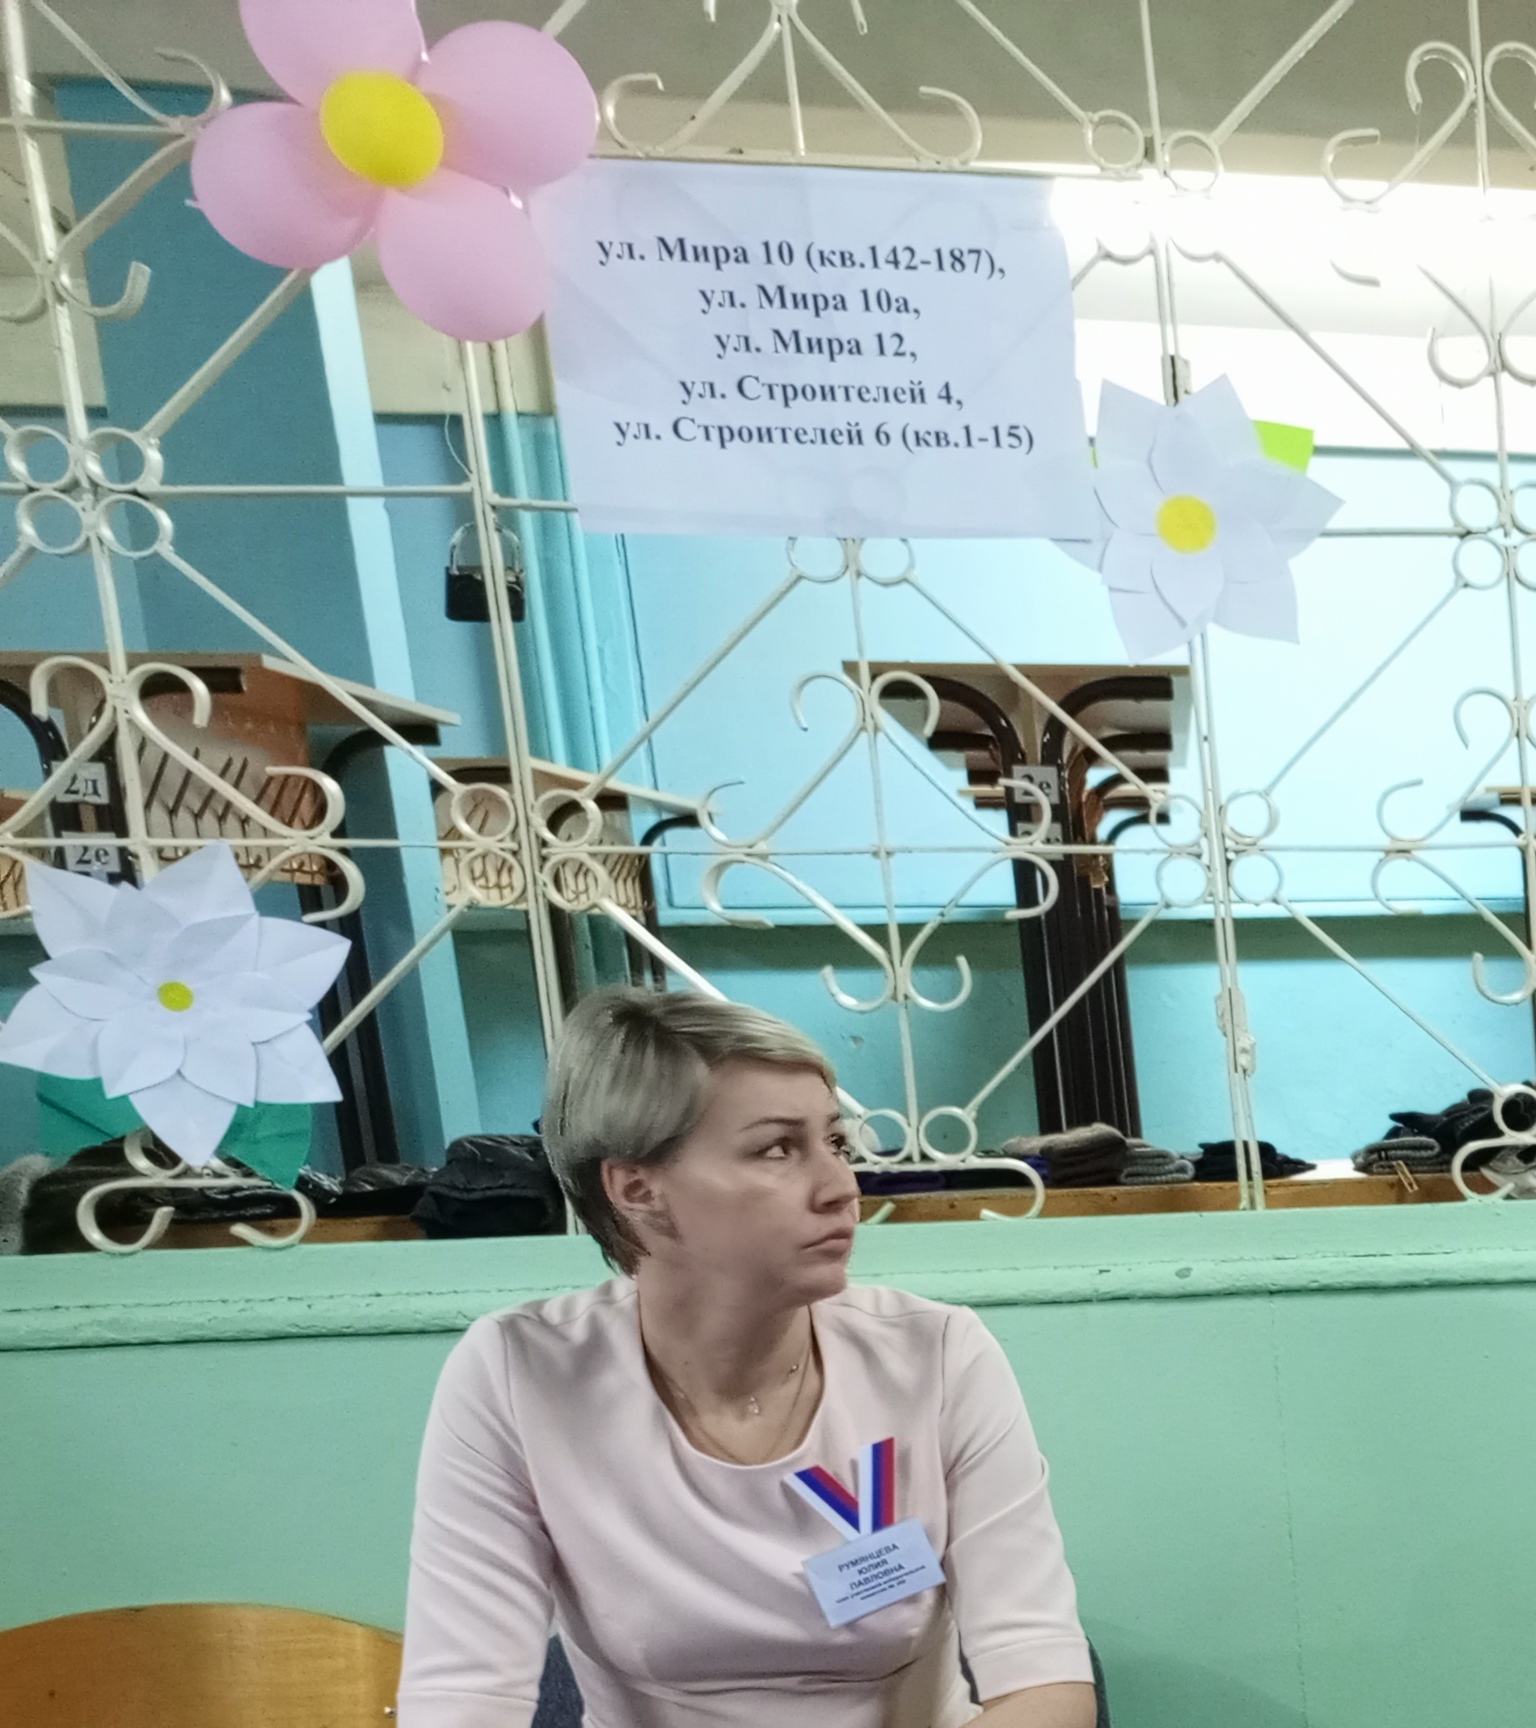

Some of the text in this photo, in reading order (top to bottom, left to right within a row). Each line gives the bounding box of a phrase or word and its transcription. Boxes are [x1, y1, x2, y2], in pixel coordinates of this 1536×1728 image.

[596, 236, 1006, 281] ул. Мира 10 (кв.142-187),
[698, 283, 921, 320] ул. Мира 10а,
[713, 328, 918, 363] ул. Мира 12,
[678, 374, 964, 411] ул. Строителей 4,
[612, 416, 1034, 455] ул. Строителей 6 (кв.1-15)
[837, 1543, 900, 1572] РУМЯНЦЕВА
[857, 1558, 889, 1576] ЮЛИЯ
[849, 1563, 906, 1591] ПАВЛОВНА
